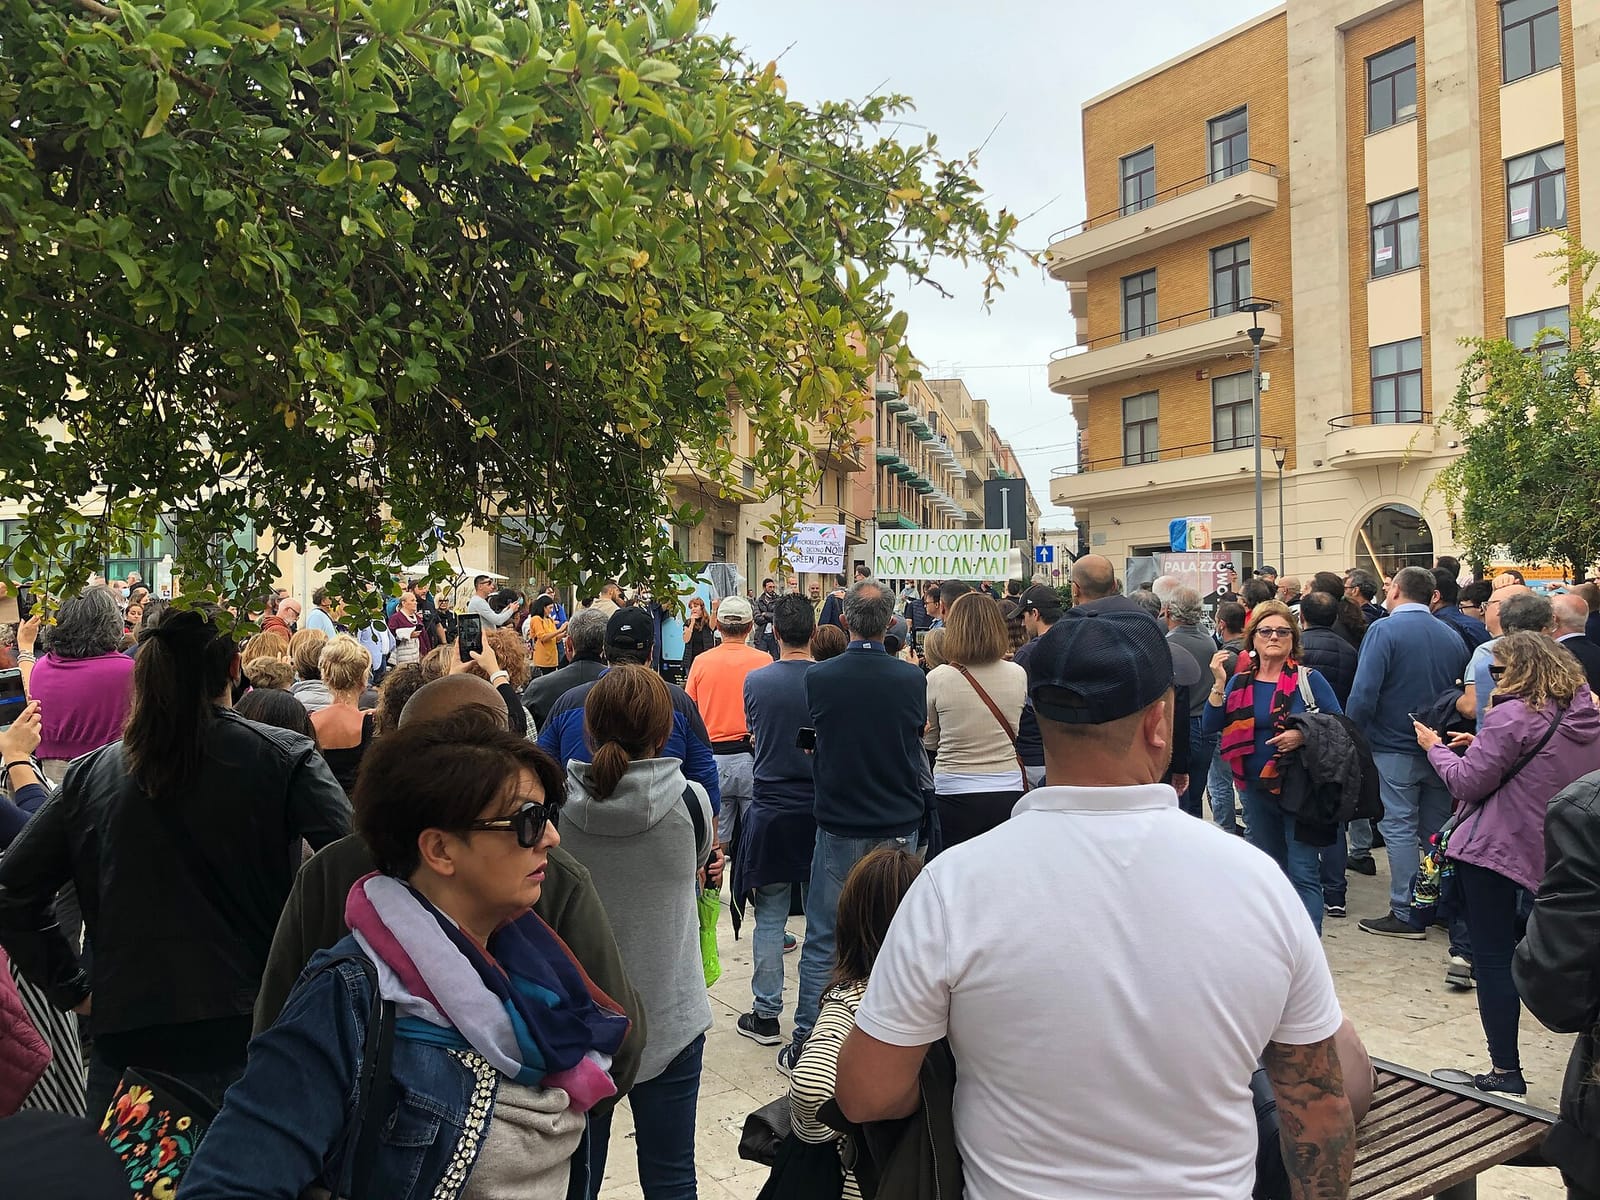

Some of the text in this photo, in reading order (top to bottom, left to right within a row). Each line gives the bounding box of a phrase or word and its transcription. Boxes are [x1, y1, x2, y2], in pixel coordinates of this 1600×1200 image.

[981, 534, 1009, 552] NOI
[790, 554, 840, 566] GREEN PASS
[876, 556, 1008, 575] NON MOLLAN MAI
[1164, 560, 1228, 573] PALAZZO
